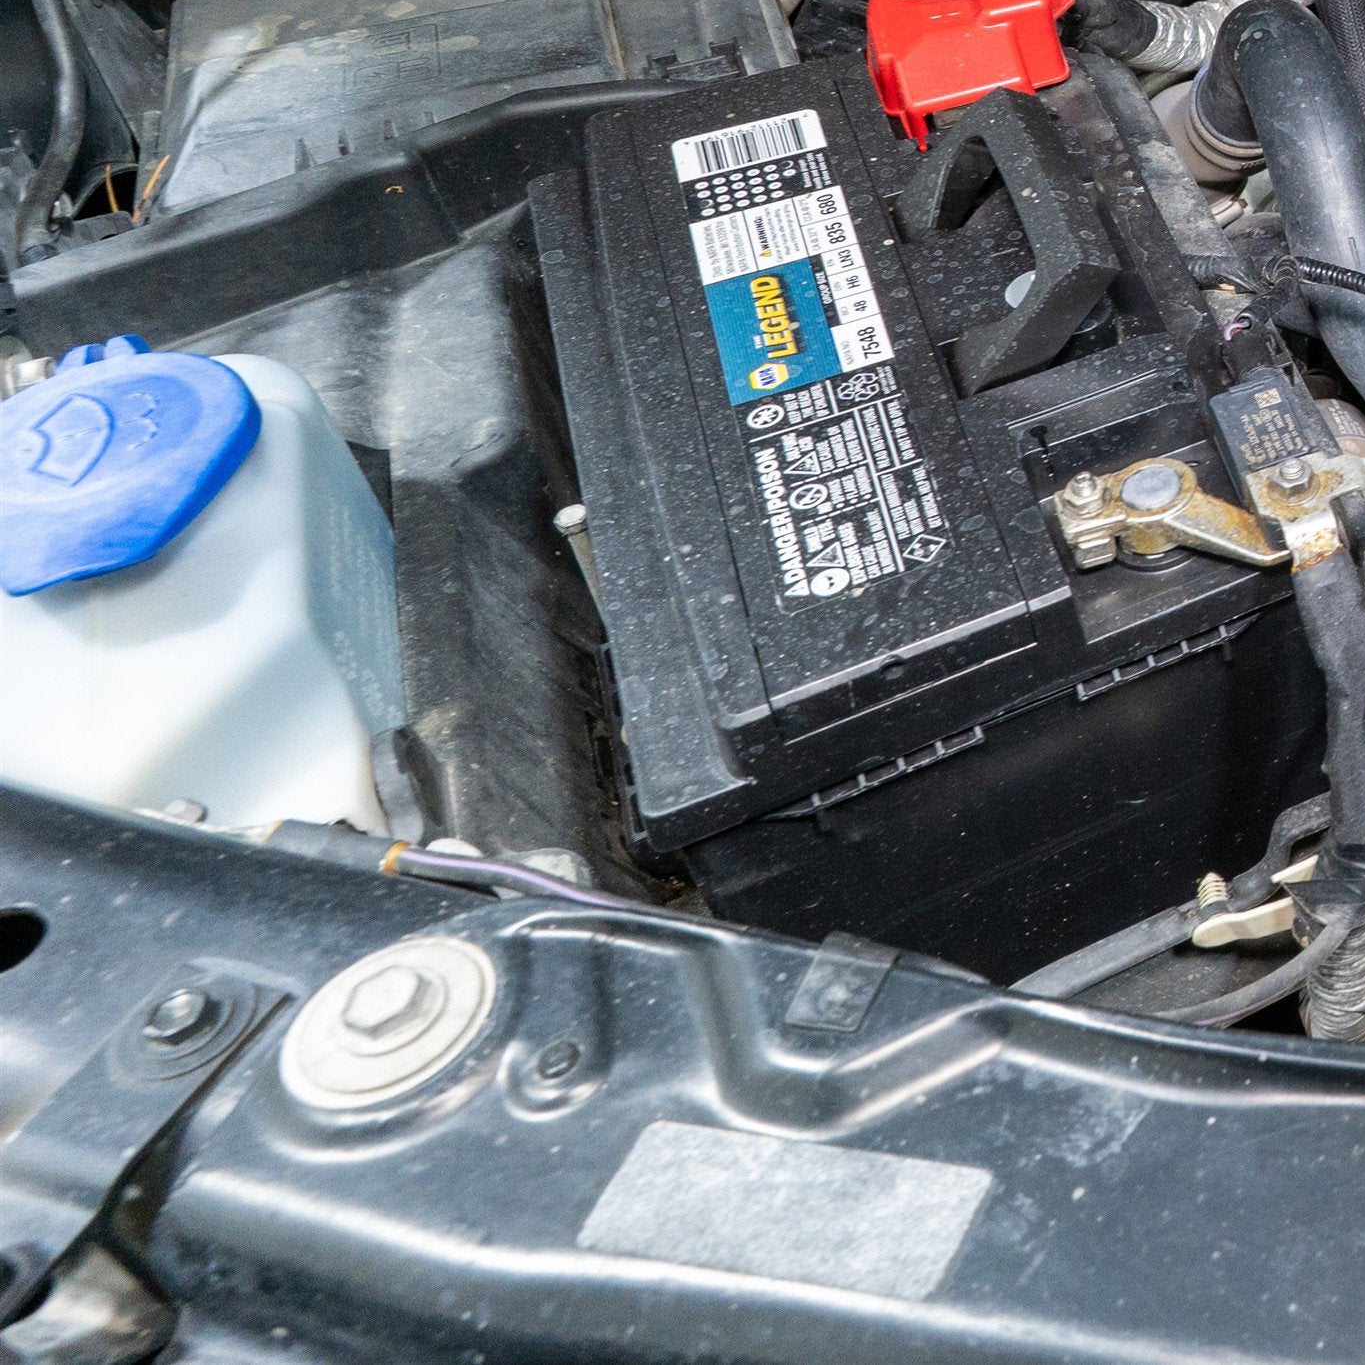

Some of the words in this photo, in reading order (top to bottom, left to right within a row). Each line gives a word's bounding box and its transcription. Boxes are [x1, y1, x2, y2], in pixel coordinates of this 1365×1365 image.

[815, 191, 838, 216] 680
[751, 214, 770, 251] WARNING:
[824, 219, 847, 245] 835
[737, 256, 751, 272] NAPA
[836, 247, 855, 268] LN3
[814, 269, 828, 285] SIZE
[844, 273, 861, 290] H6
[817, 282, 833, 305] GROUP
[748, 271, 797, 361] LEGEND
[852, 298, 869, 314] 48
[751, 332, 763, 349] THE
[855, 324, 882, 360] 7548
[757, 365, 777, 387] NAPA
[815, 438, 833, 461] CAUSE
[896, 434, 913, 451] NOT
[873, 449, 891, 470] READ
[840, 472, 859, 500] FLAMES
[753, 446, 807, 585] DANGER/POISON
[836, 520, 857, 547] GASES
[843, 543, 868, 586] EXPLOSIVE
[859, 543, 878, 567] CAUSE
